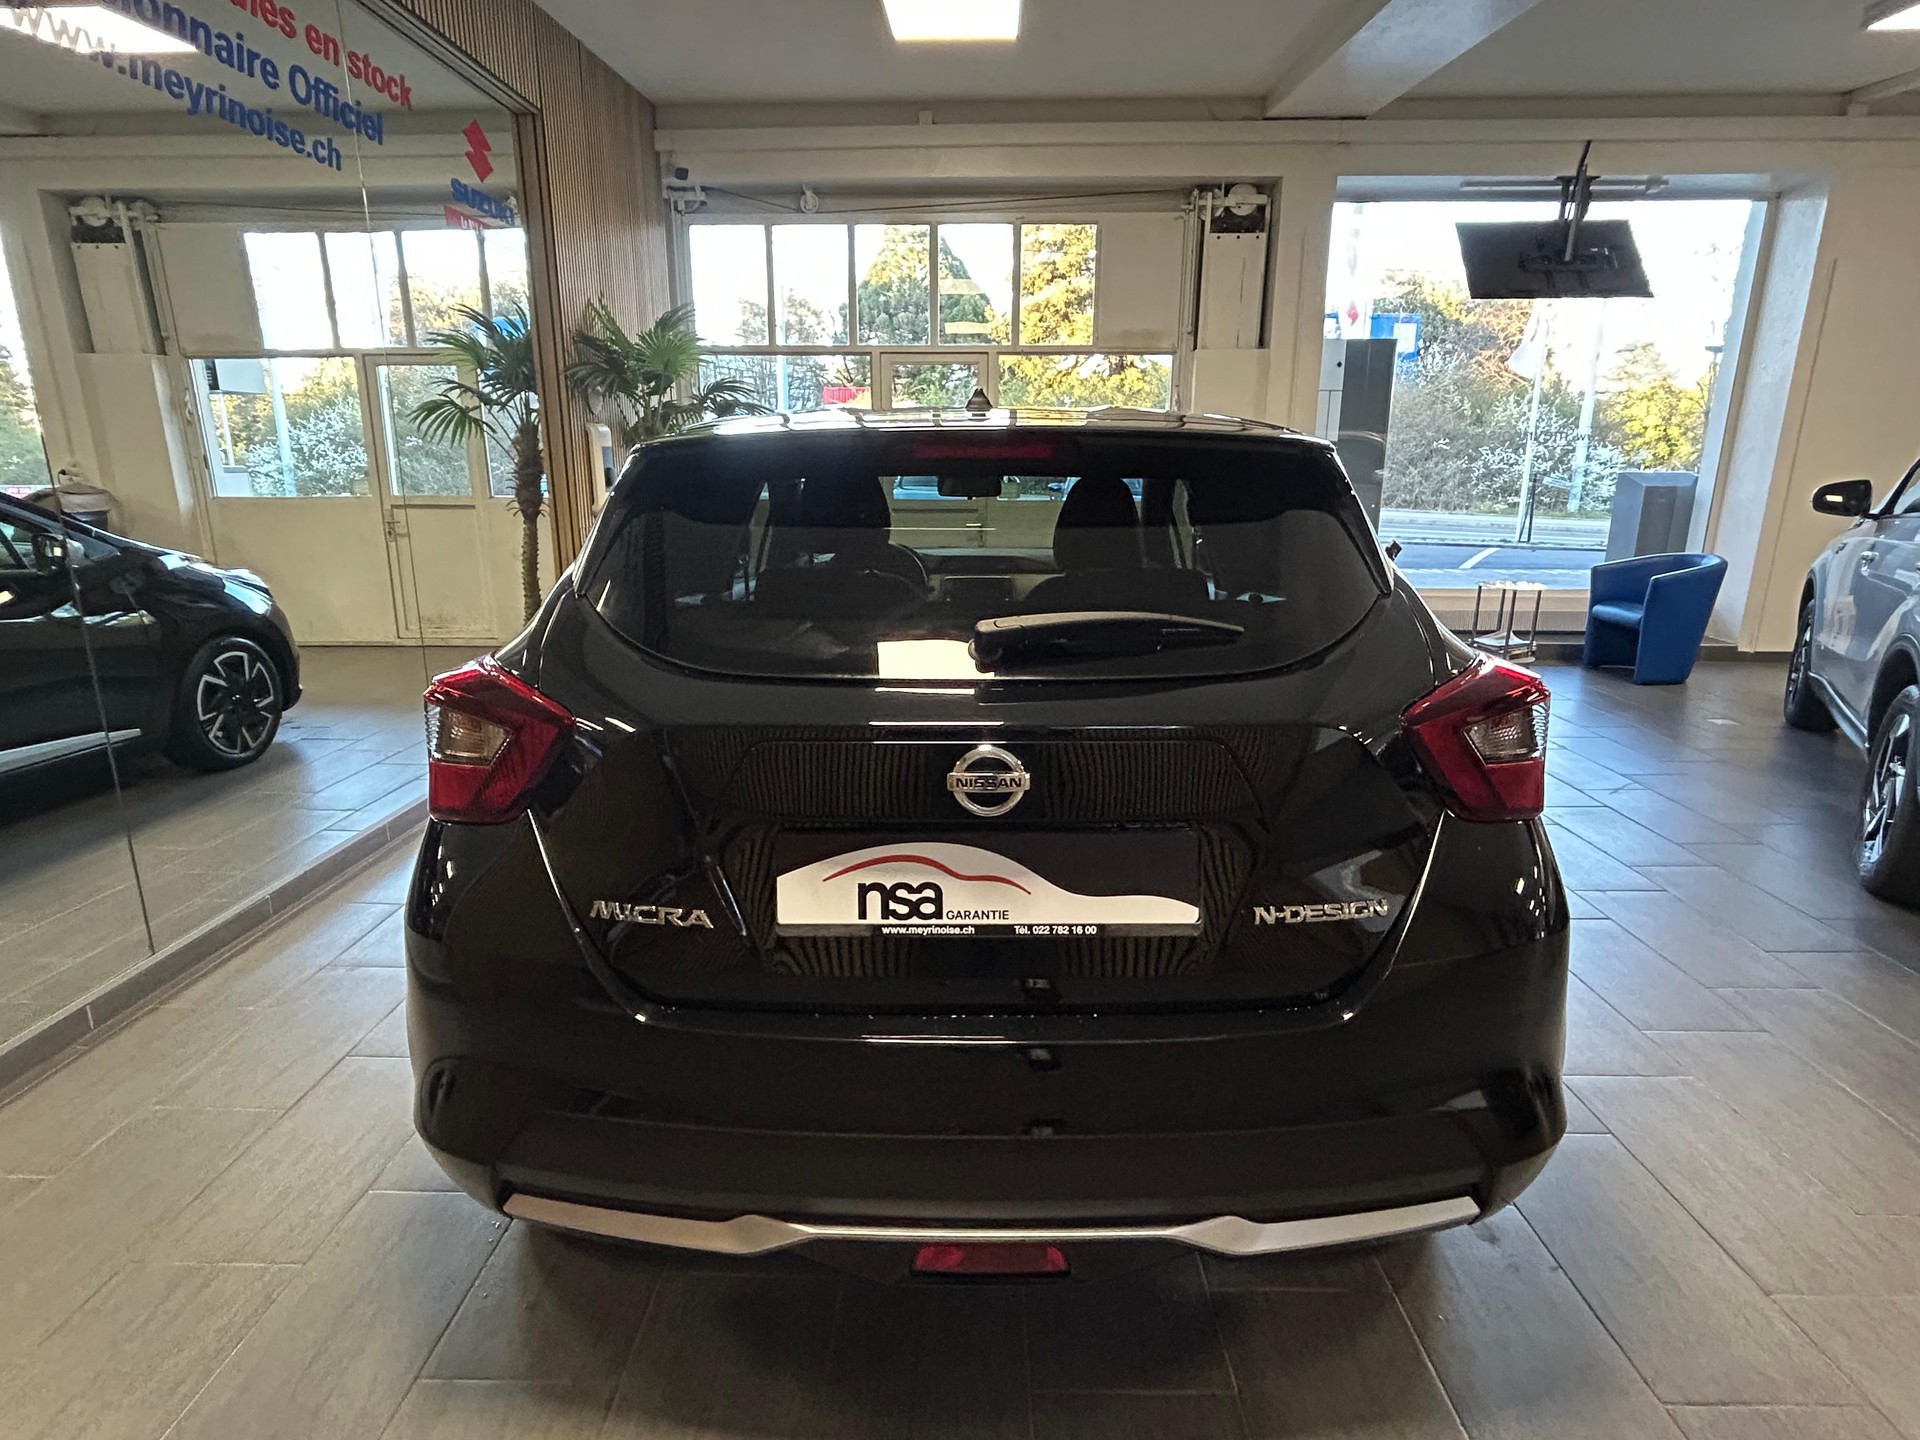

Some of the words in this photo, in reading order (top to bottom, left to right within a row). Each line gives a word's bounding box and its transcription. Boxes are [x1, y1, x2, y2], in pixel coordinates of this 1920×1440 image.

[305, 24, 340, 67] en
[347, 50, 413, 111] stock
[288, 64, 384, 146] Officiel
[451, 178, 515, 226] SUZUKI
[955, 777, 1022, 788] NISSAN
[590, 900, 714, 928] MICRA
[857, 881, 943, 921] nsa
[946, 910, 1010, 920] GARANTIE
[1253, 899, 1388, 925] N-DESIGN
[881, 925, 976, 936] www.meyrinoise.ch
[1013, 925, 1031, 935] Tél.
[1032, 925, 1050, 935] 022
[1052, 925, 1070, 935] 782
[1071, 925, 1083, 935] 16
[1084, 925, 1097, 935] 00
